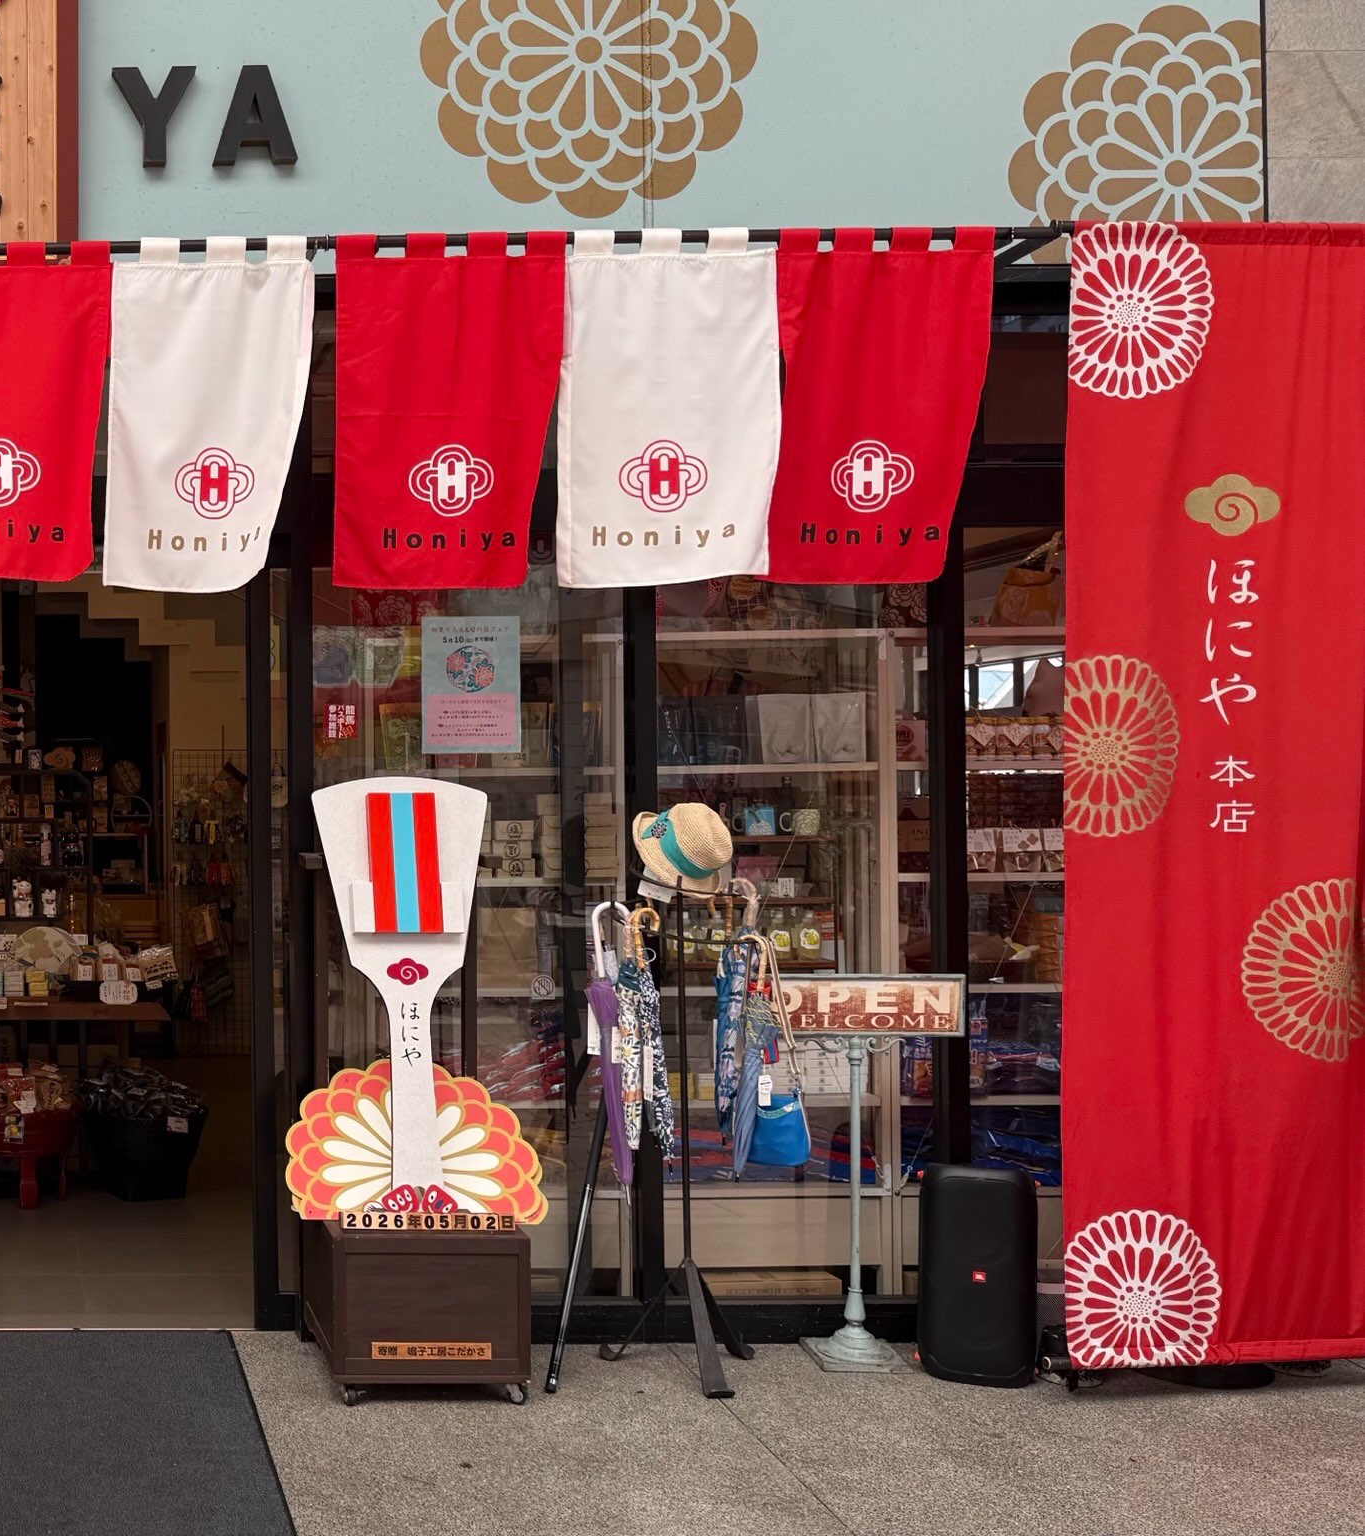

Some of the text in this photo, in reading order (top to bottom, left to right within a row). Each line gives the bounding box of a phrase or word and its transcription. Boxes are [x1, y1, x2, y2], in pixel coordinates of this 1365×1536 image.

[382, 527, 516, 550] Honiya
[591, 519, 736, 549] Honiya
[800, 521, 940, 547] Honiya
[1197, 558, 1258, 835] ほにや 本店
[770, 986, 951, 1014] OPEN
[400, 1002, 422, 1068] ほにや
[346, 1213, 514, 1230] 2026年05月02日
